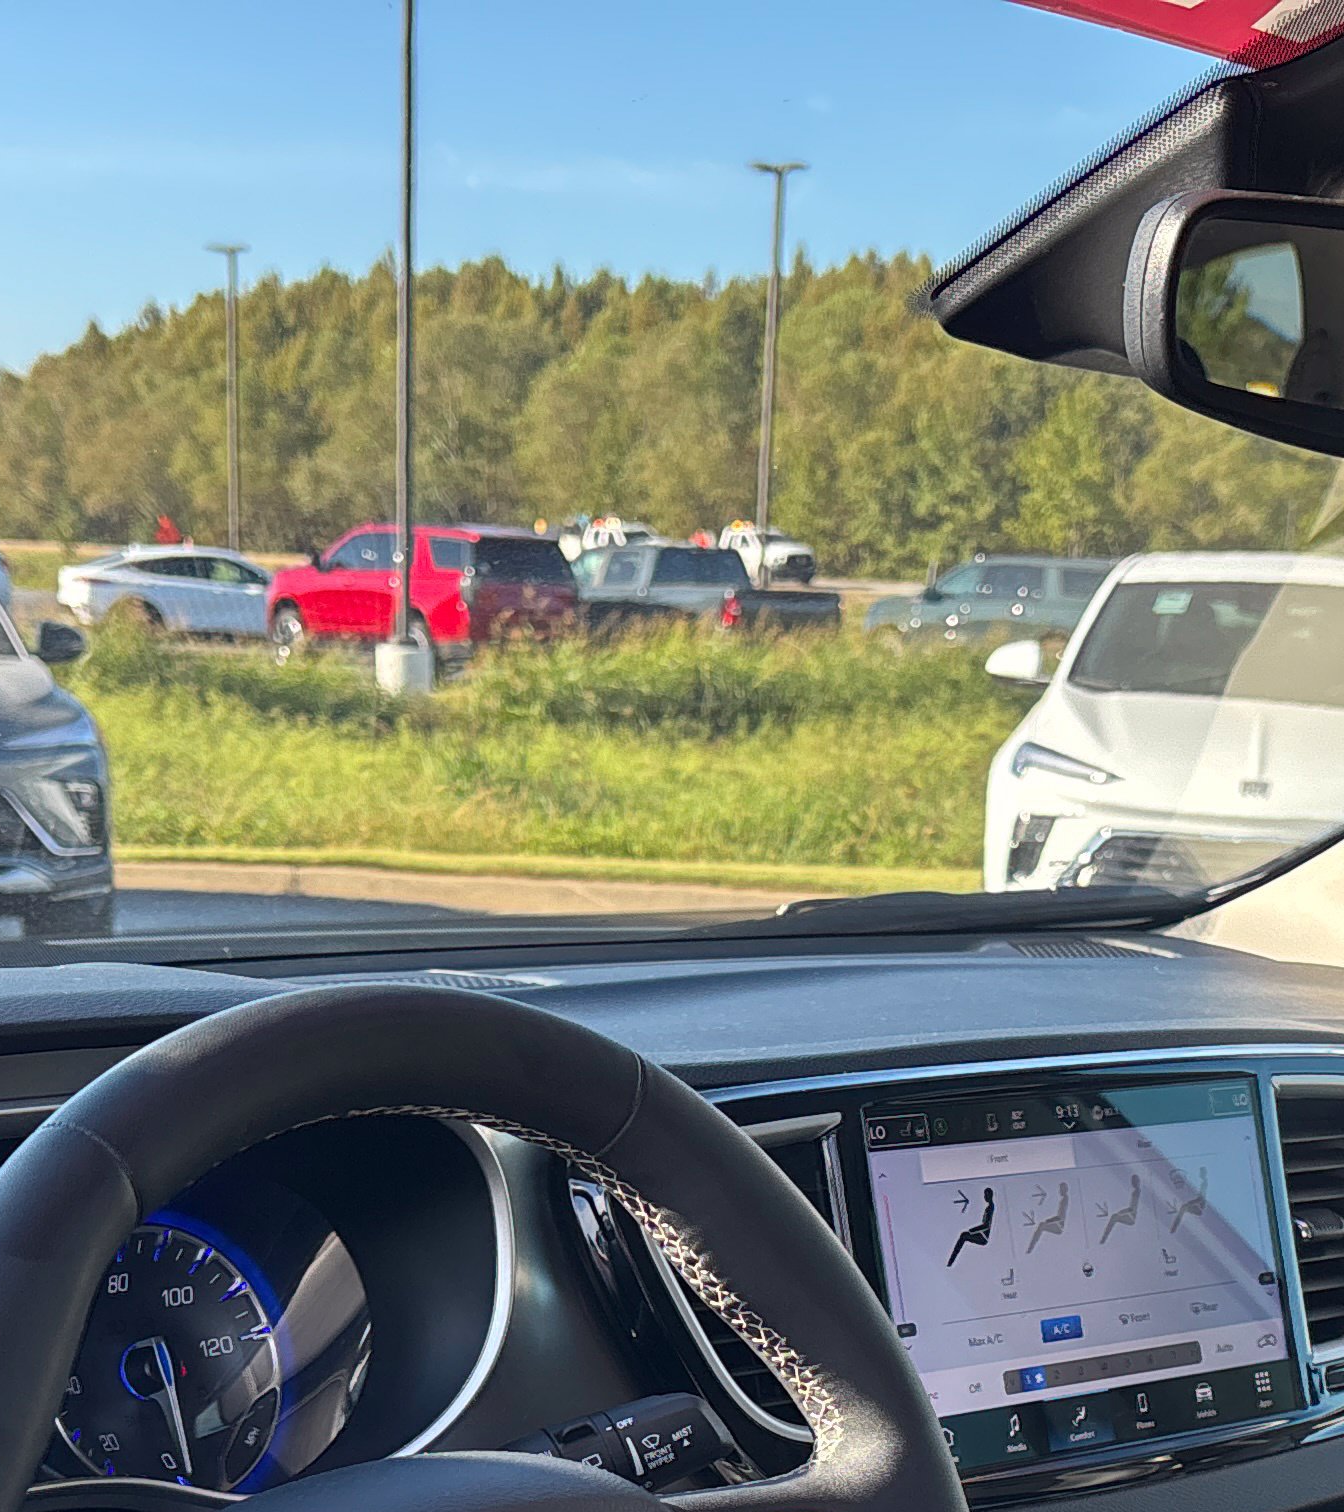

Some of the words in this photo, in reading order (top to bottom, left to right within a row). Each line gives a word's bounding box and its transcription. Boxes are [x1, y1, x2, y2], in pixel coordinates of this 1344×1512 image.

[1056, 1104, 1080, 1119] 9:13
[869, 1125, 887, 1141] LO
[107, 1273, 129, 1294] 80
[161, 1285, 194, 1308] 100
[1053, 1323, 1071, 1336] A/C
[199, 1335, 234, 1358] 120
[616, 1416, 635, 1431] OFF
[98, 1433, 120, 1451] 20
[671, 1424, 693, 1442] MIST
[160, 1452, 177, 1470] 0
[643, 1443, 672, 1463] FRONT
[647, 1452, 676, 1470] WIPER
